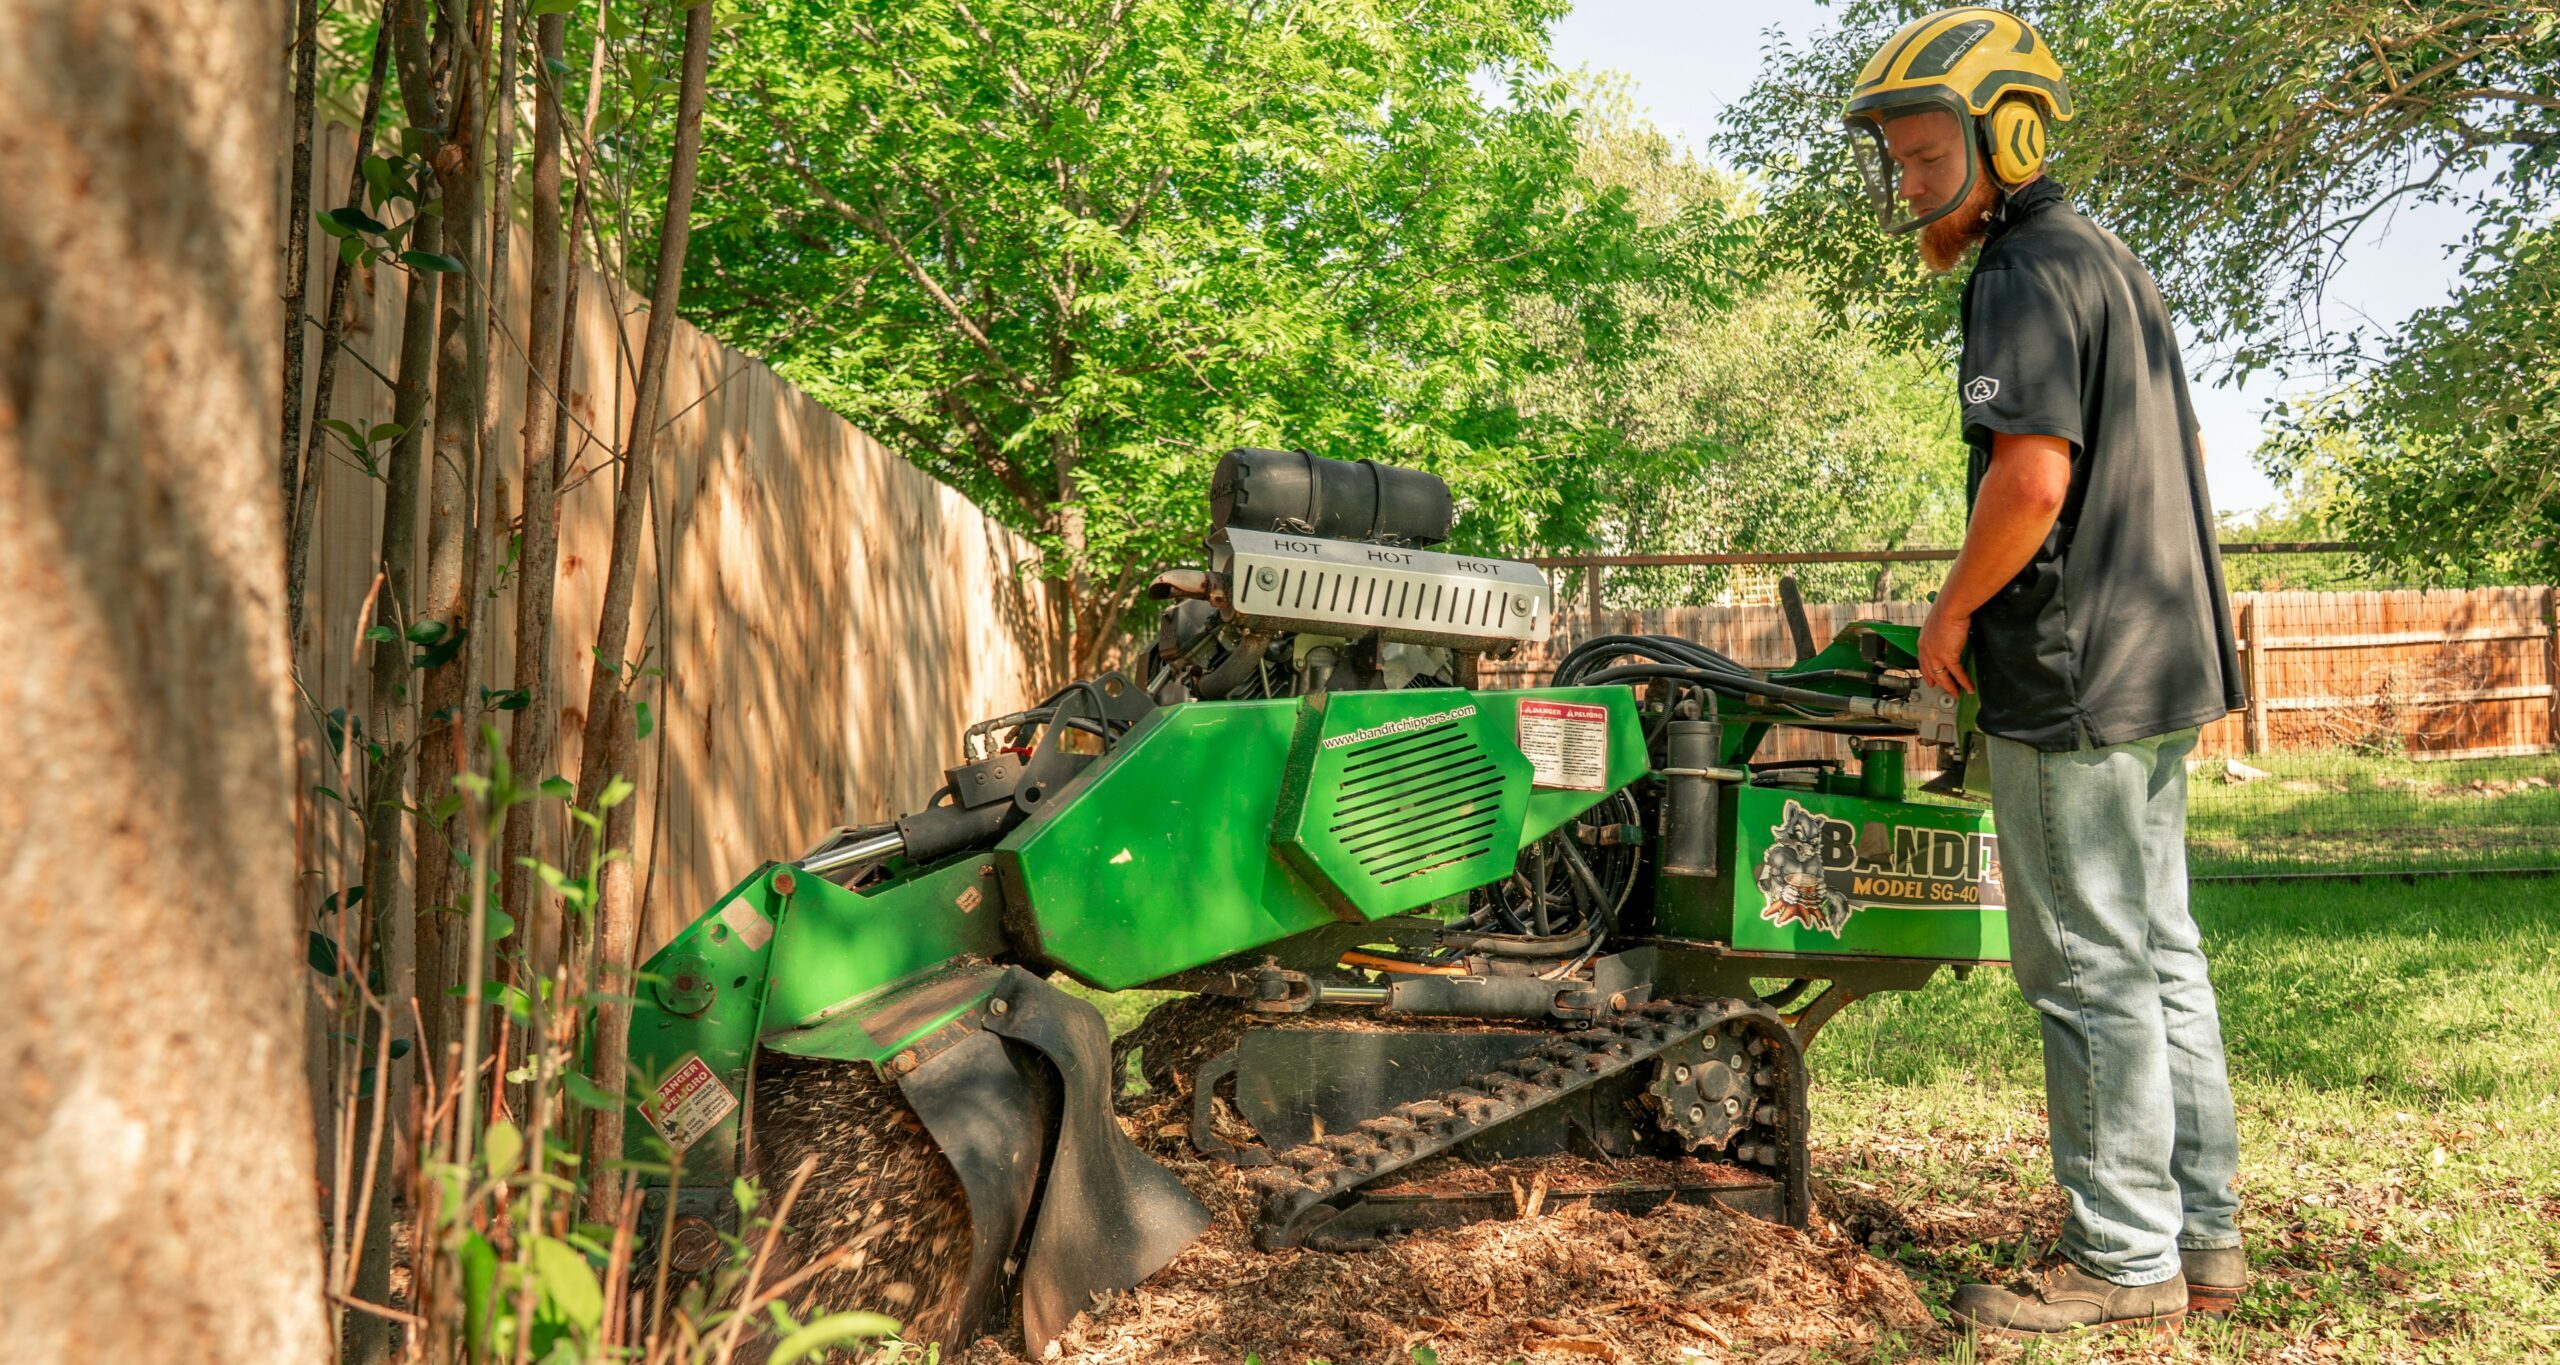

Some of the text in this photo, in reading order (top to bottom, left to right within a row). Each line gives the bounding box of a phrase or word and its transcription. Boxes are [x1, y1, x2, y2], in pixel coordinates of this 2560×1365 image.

[1274, 539, 1500, 576] HOT HOT HOT
[1533, 706, 1562, 716] DANGER
[1574, 711, 1603, 719] PELIGRO
[1323, 705, 1476, 749] www.banditchippers.com
[1852, 876, 1979, 903] MODEL SG-40
